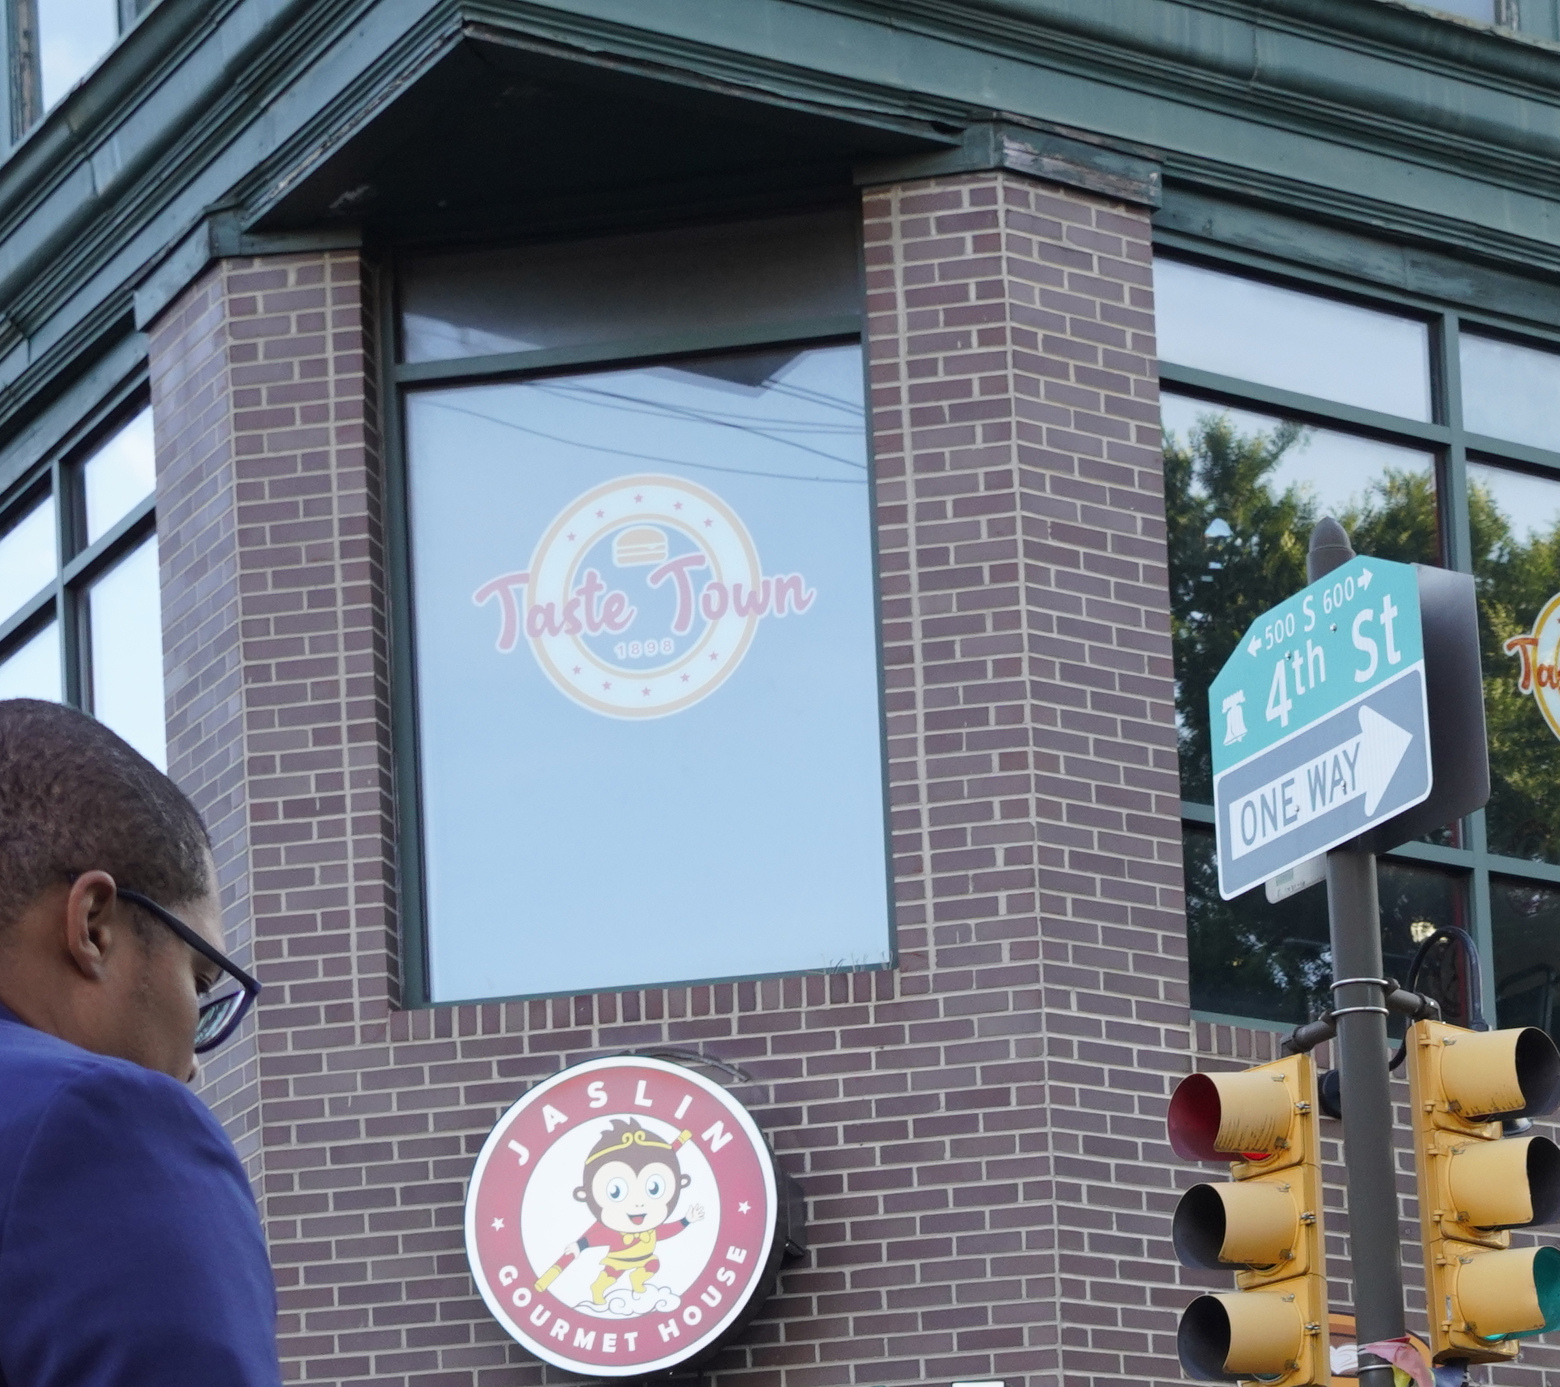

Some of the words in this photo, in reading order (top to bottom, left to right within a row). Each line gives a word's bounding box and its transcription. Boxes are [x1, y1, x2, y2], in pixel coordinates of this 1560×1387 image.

[475, 570, 636, 650] Taste
[649, 554, 814, 632] Town
[616, 638, 673, 657] 1898
[1265, 612, 1296, 651] 500
[1303, 594, 1316, 633] S
[1323, 576, 1354, 614] 600
[1265, 638, 1326, 728] 4th
[1352, 593, 1402, 683] St
[1241, 778, 1298, 847] ONE
[1307, 742, 1361, 812] WAY
[508, 1080, 733, 1166] JASLIN
[498, 1264, 639, 1354] GOURMET
[658, 1245, 748, 1343] HOUSE
